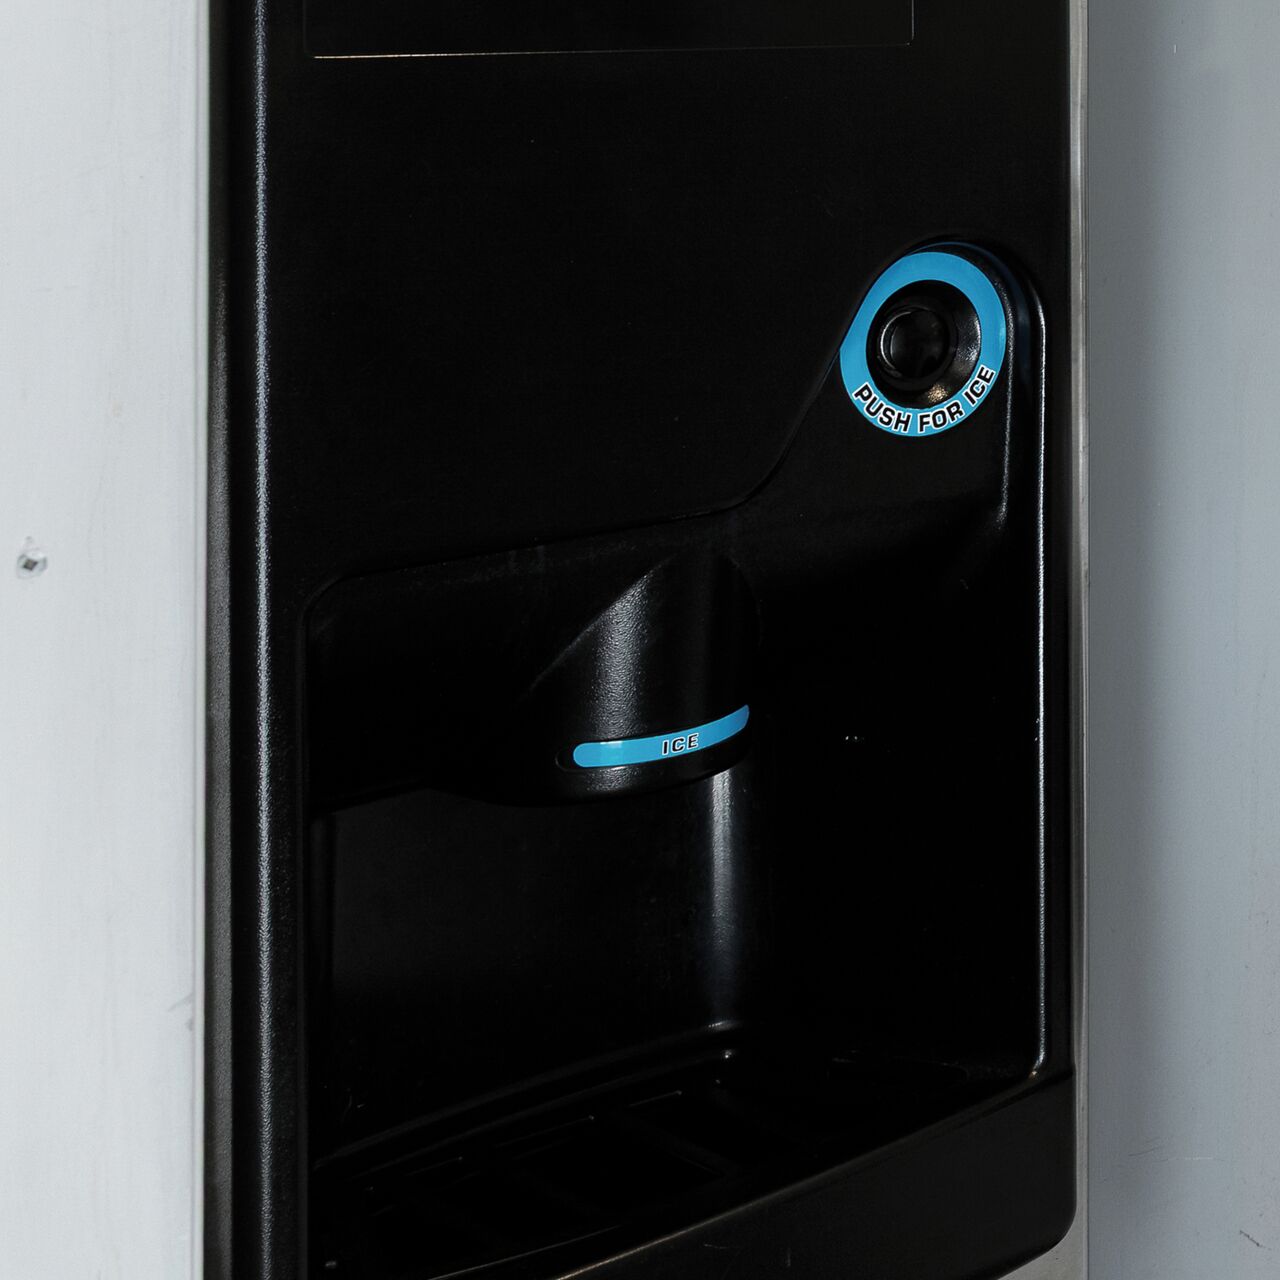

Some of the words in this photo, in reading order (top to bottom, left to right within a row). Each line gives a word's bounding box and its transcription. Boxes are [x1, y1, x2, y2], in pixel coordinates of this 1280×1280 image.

[854, 384, 911, 431] PUSH
[919, 402, 964, 432] FOR
[969, 366, 995, 404] ICE
[662, 733, 699, 755] ICE
